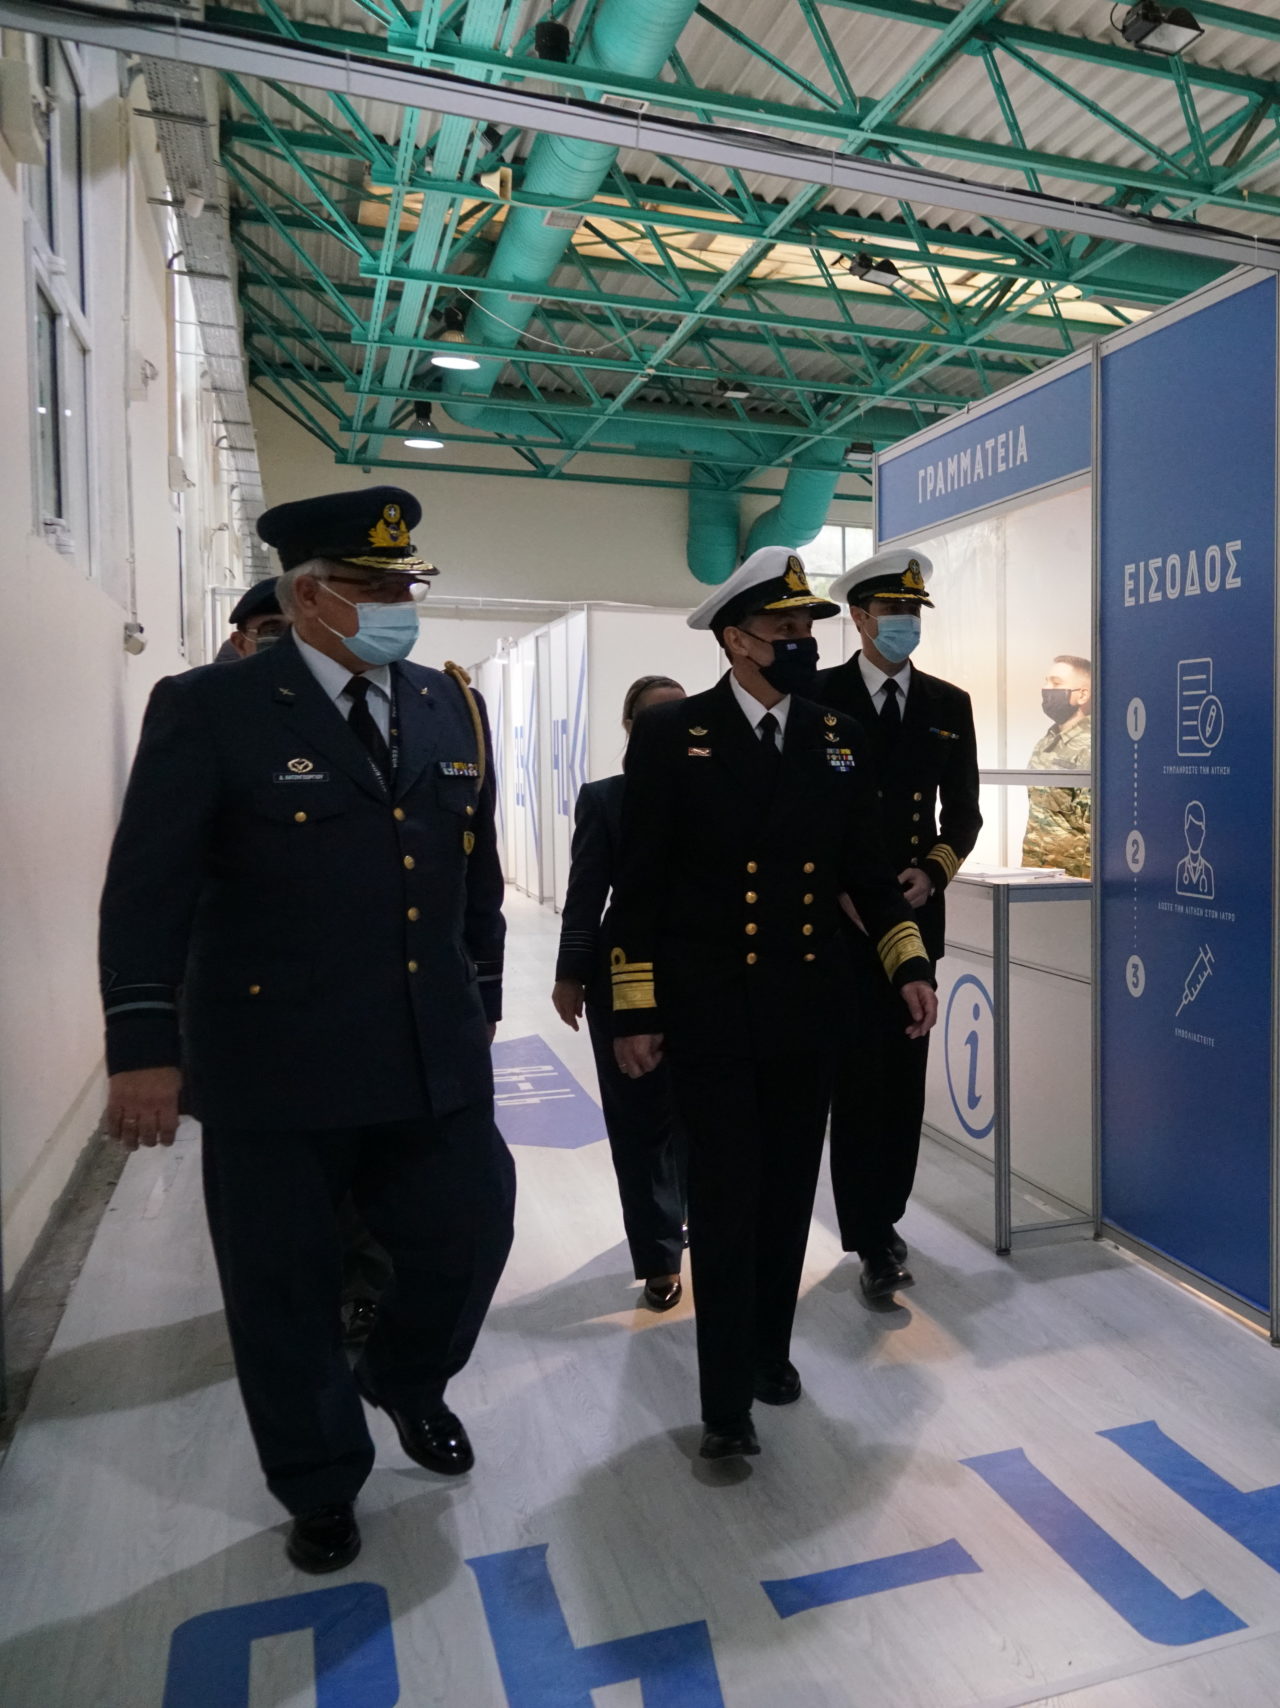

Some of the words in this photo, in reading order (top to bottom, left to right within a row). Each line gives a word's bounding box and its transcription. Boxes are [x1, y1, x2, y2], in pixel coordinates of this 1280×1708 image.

[918, 425, 1028, 504] ΓΡΑΜΜΑΤΕΙΑ
[1124, 540, 1242, 607] ΕΙΣΟΔΟΣ
[1133, 706, 1139, 731] 1
[1131, 839, 1139, 864] 2
[1131, 964, 1139, 988] 3
